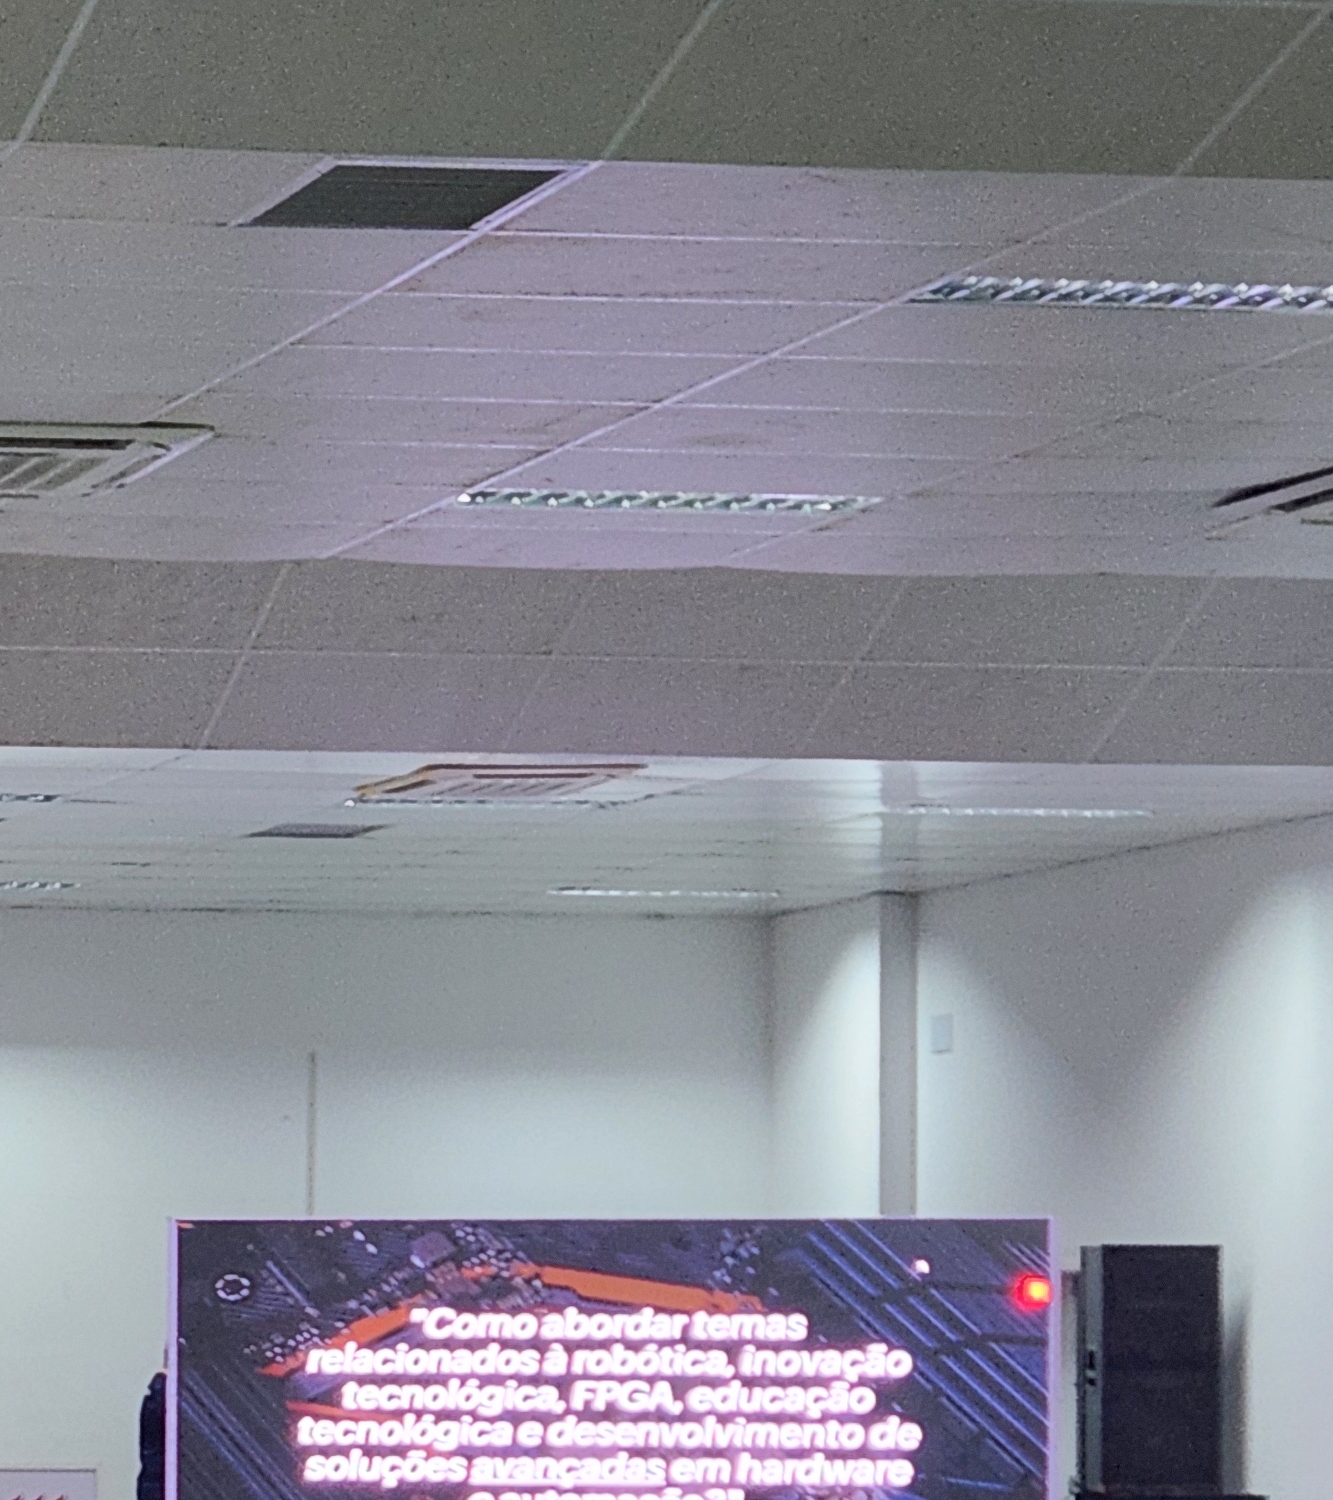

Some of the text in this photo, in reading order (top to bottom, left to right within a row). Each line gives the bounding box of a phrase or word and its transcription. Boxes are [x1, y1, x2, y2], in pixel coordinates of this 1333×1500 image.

[410, 1307, 809, 1341] "Como abordar temas
[304, 1341, 913, 1383] relacionados à robótica, inovação
[341, 1378, 877, 1419] tecnológica, FPGA, educação
[297, 1413, 923, 1450] tecnológica e desenvolvimento de
[303, 1448, 915, 1488] soluções avançadas em hardware
